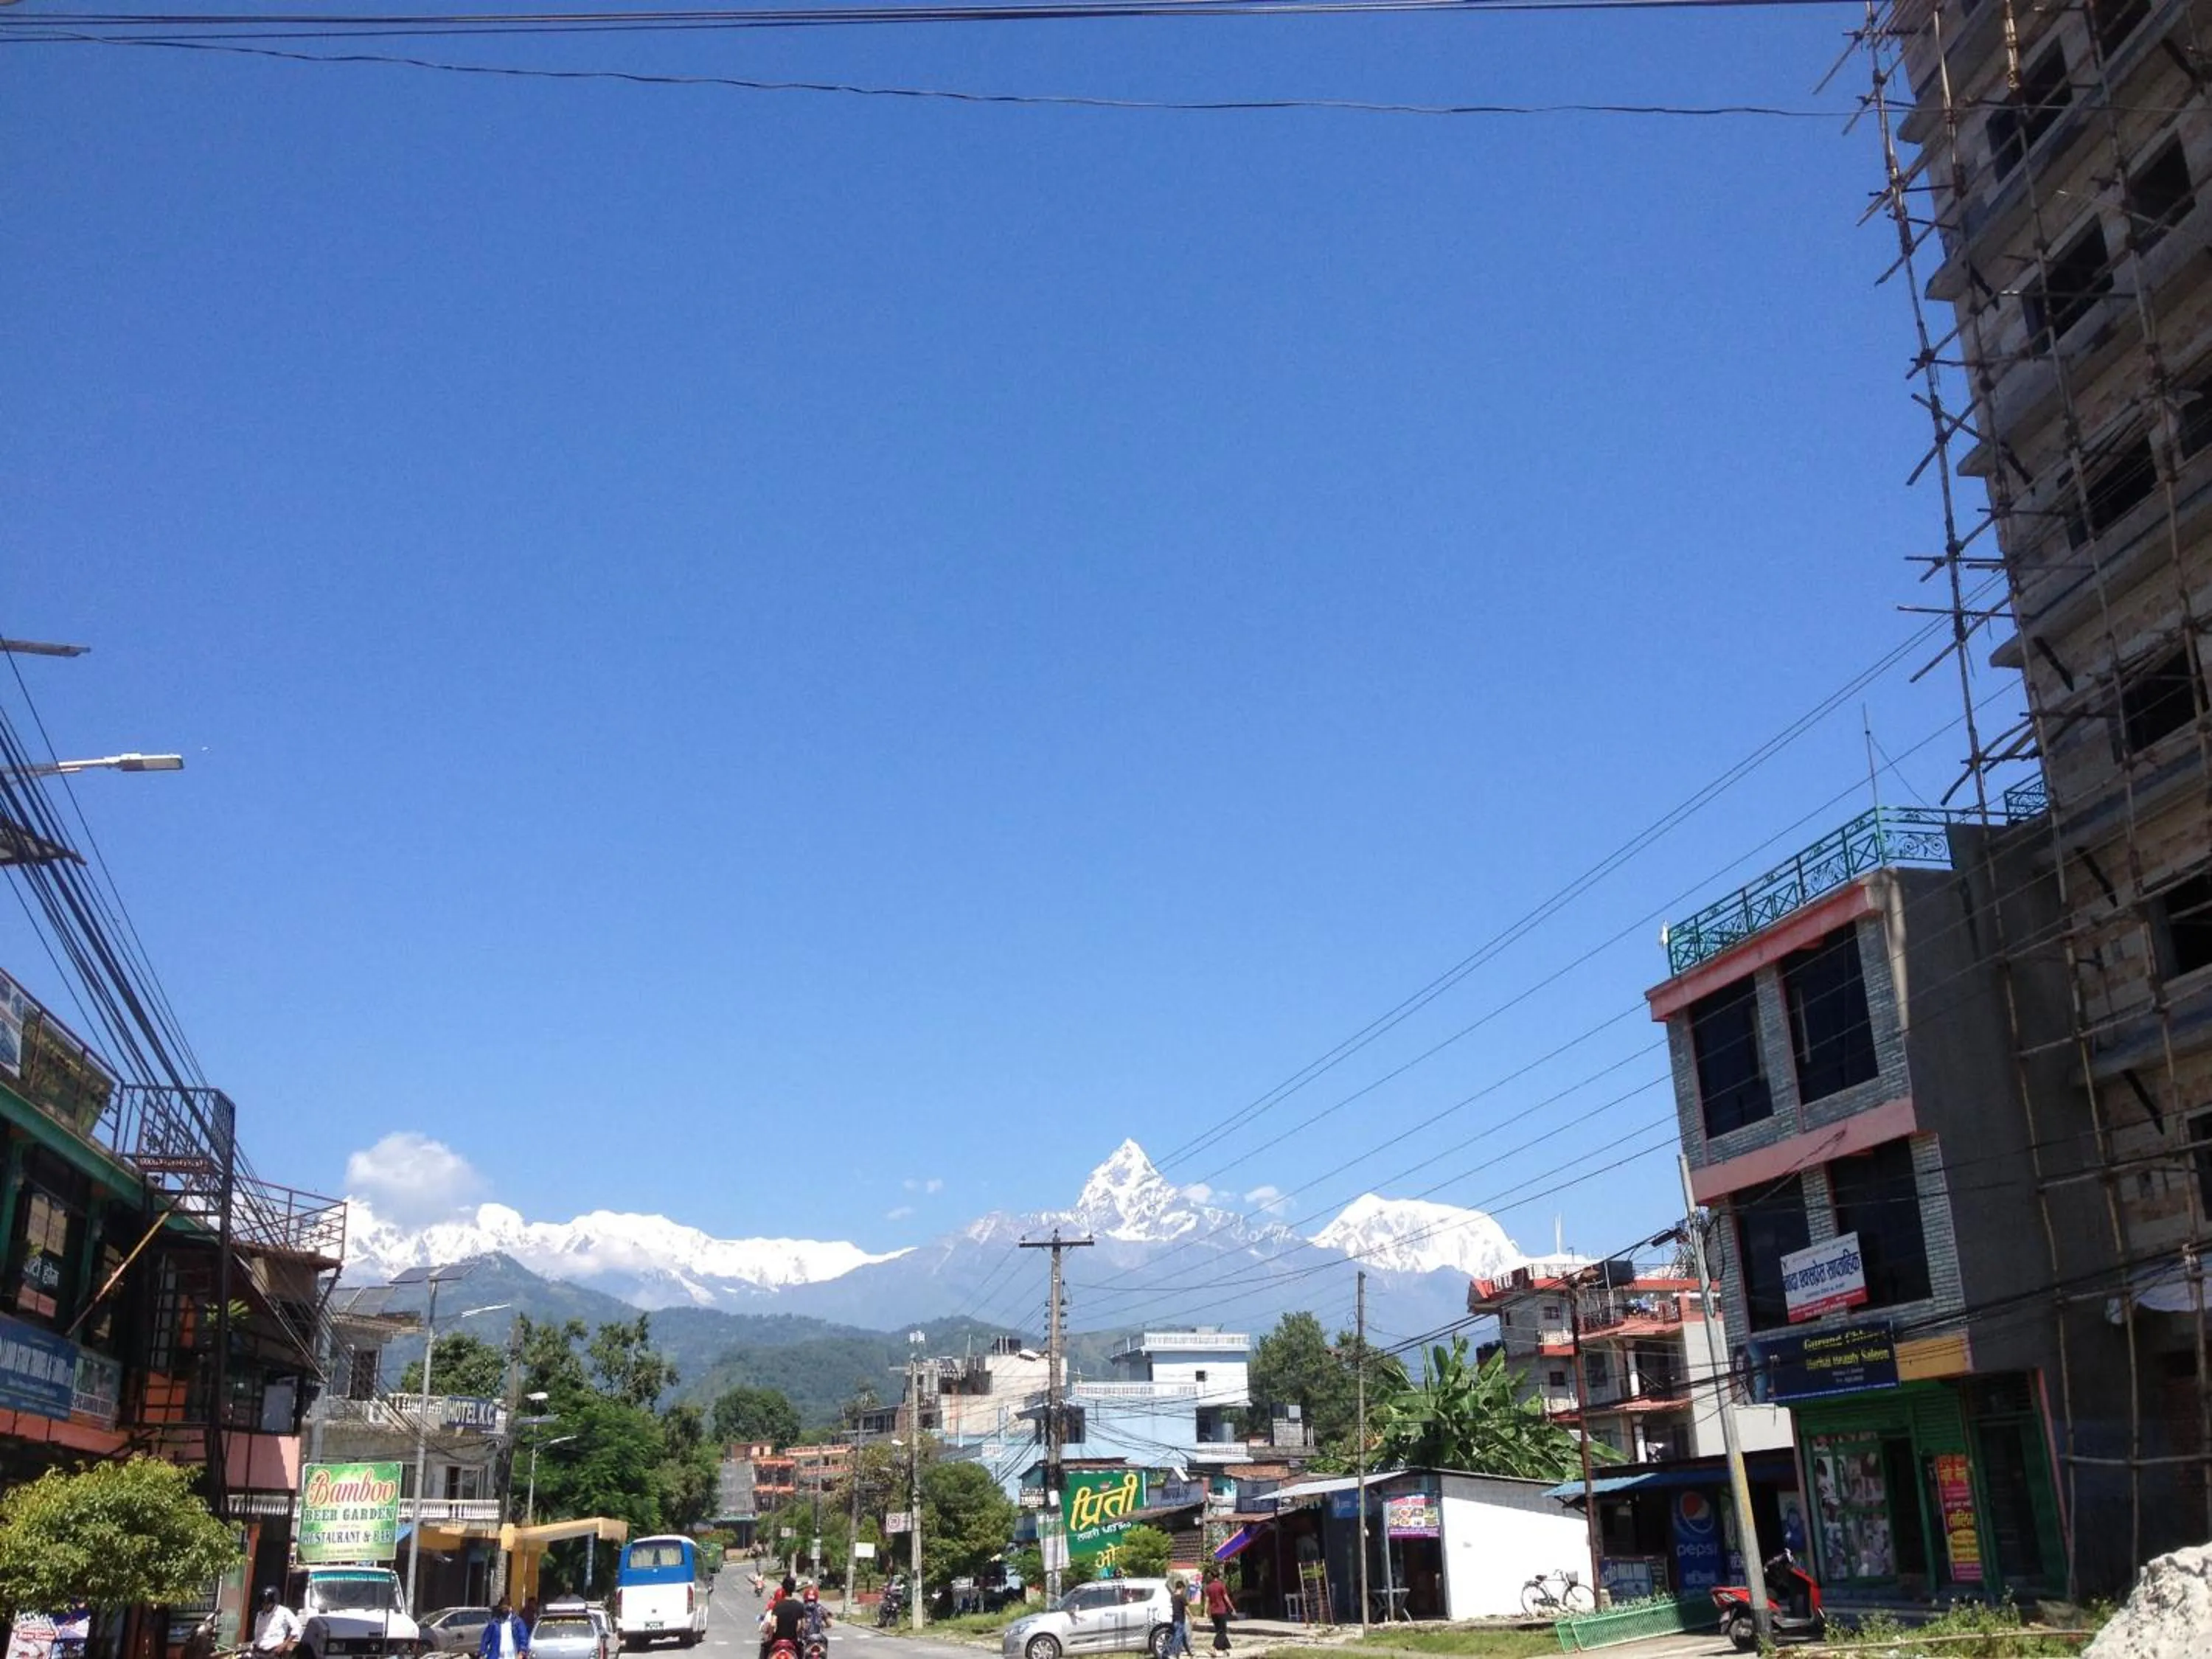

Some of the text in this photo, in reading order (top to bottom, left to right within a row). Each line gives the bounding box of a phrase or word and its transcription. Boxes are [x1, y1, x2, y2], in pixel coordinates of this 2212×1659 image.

[448, 1399, 477, 1425] HOTEL
[307, 1467, 396, 1507] Bamboo
[305, 1508, 394, 1521] BEER GARDEN
[1676, 1543, 1719, 1557] pepsi
